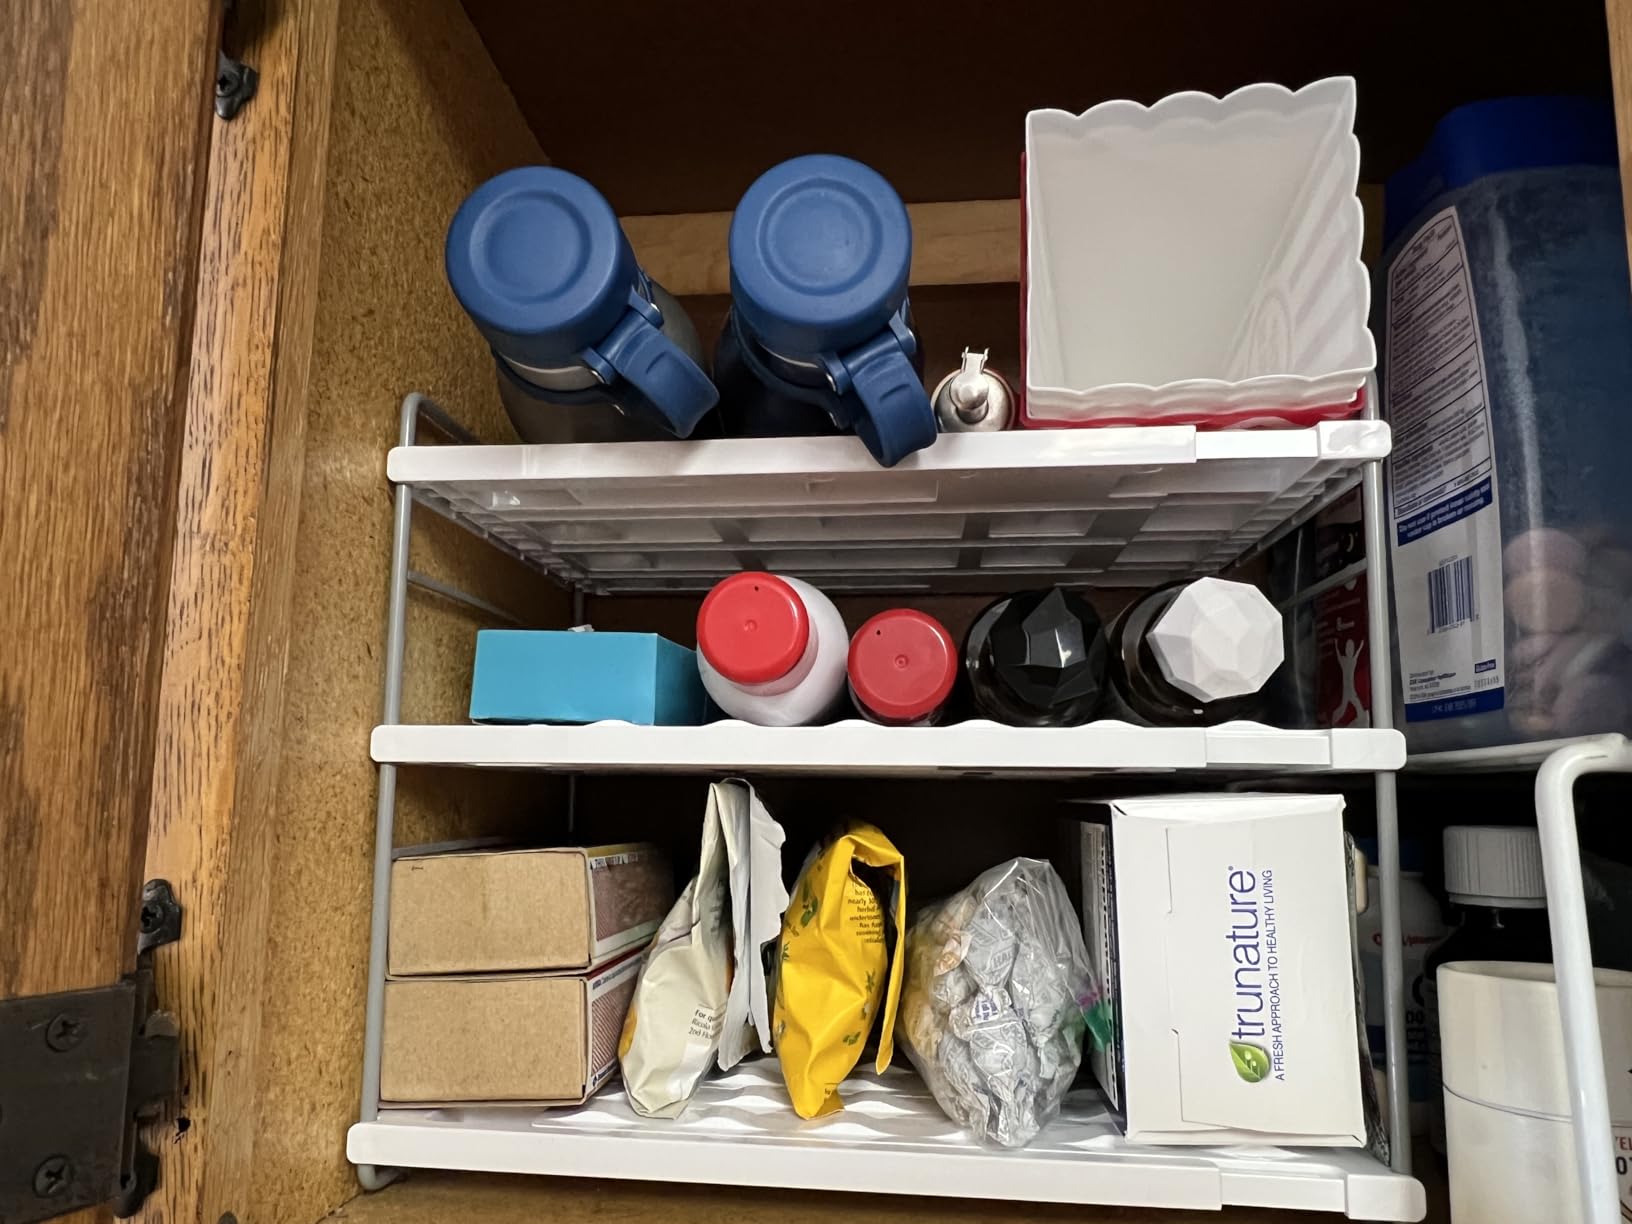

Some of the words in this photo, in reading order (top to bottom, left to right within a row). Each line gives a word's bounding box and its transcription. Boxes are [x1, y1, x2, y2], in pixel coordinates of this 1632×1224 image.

[1262, 869, 1275, 904] LIVING
[1264, 906, 1277, 954] HEALTHY
[1225, 870, 1266, 1039] trunature
[1267, 956, 1279, 971] TO
[694, 1009, 707, 1019] For
[1268, 973, 1283, 1033] APPROACH
[688, 1027, 702, 1037] 2nd
[691, 1018, 711, 1030] Ricola
[1271, 1034, 1285, 1072] FRESH
[1274, 1073, 1286, 1082] A
